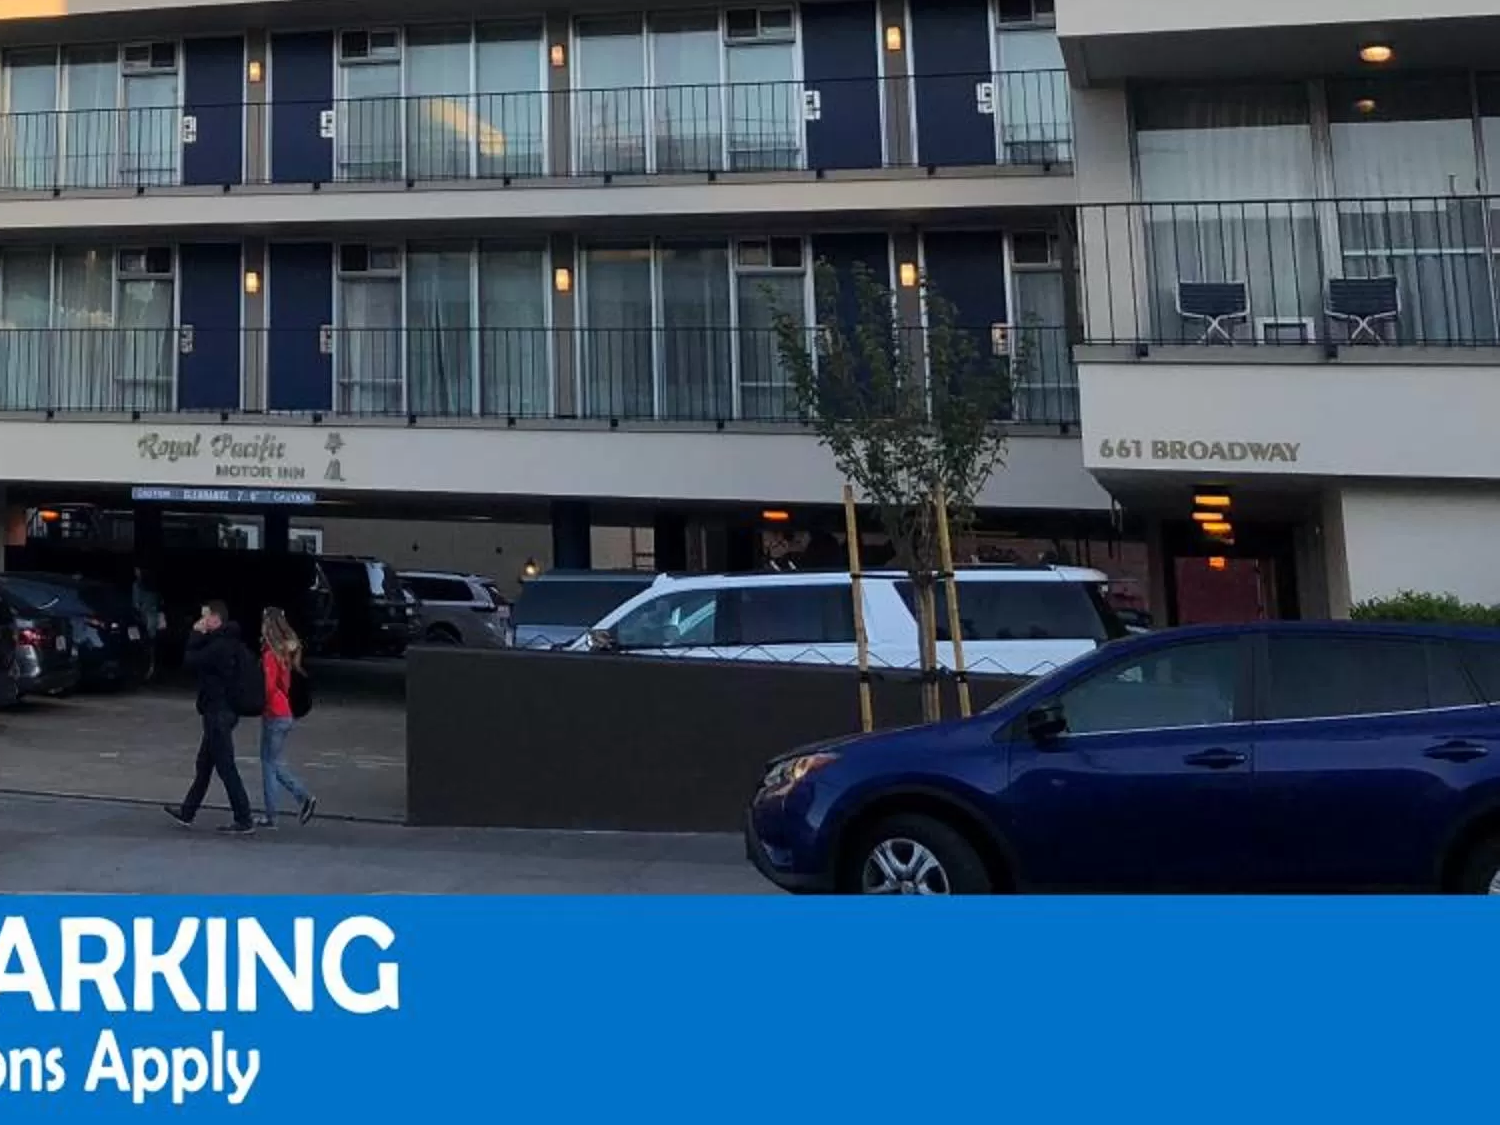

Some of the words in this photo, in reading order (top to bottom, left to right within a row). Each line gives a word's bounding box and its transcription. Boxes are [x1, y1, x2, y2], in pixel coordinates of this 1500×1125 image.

[137, 431, 202, 463] Royal
[210, 432, 287, 463] Pacific
[1100, 439, 1142, 460] 661
[1151, 440, 1300, 462] BROADWAY
[215, 464, 273, 478] MOTOR
[277, 466, 306, 480] INN
